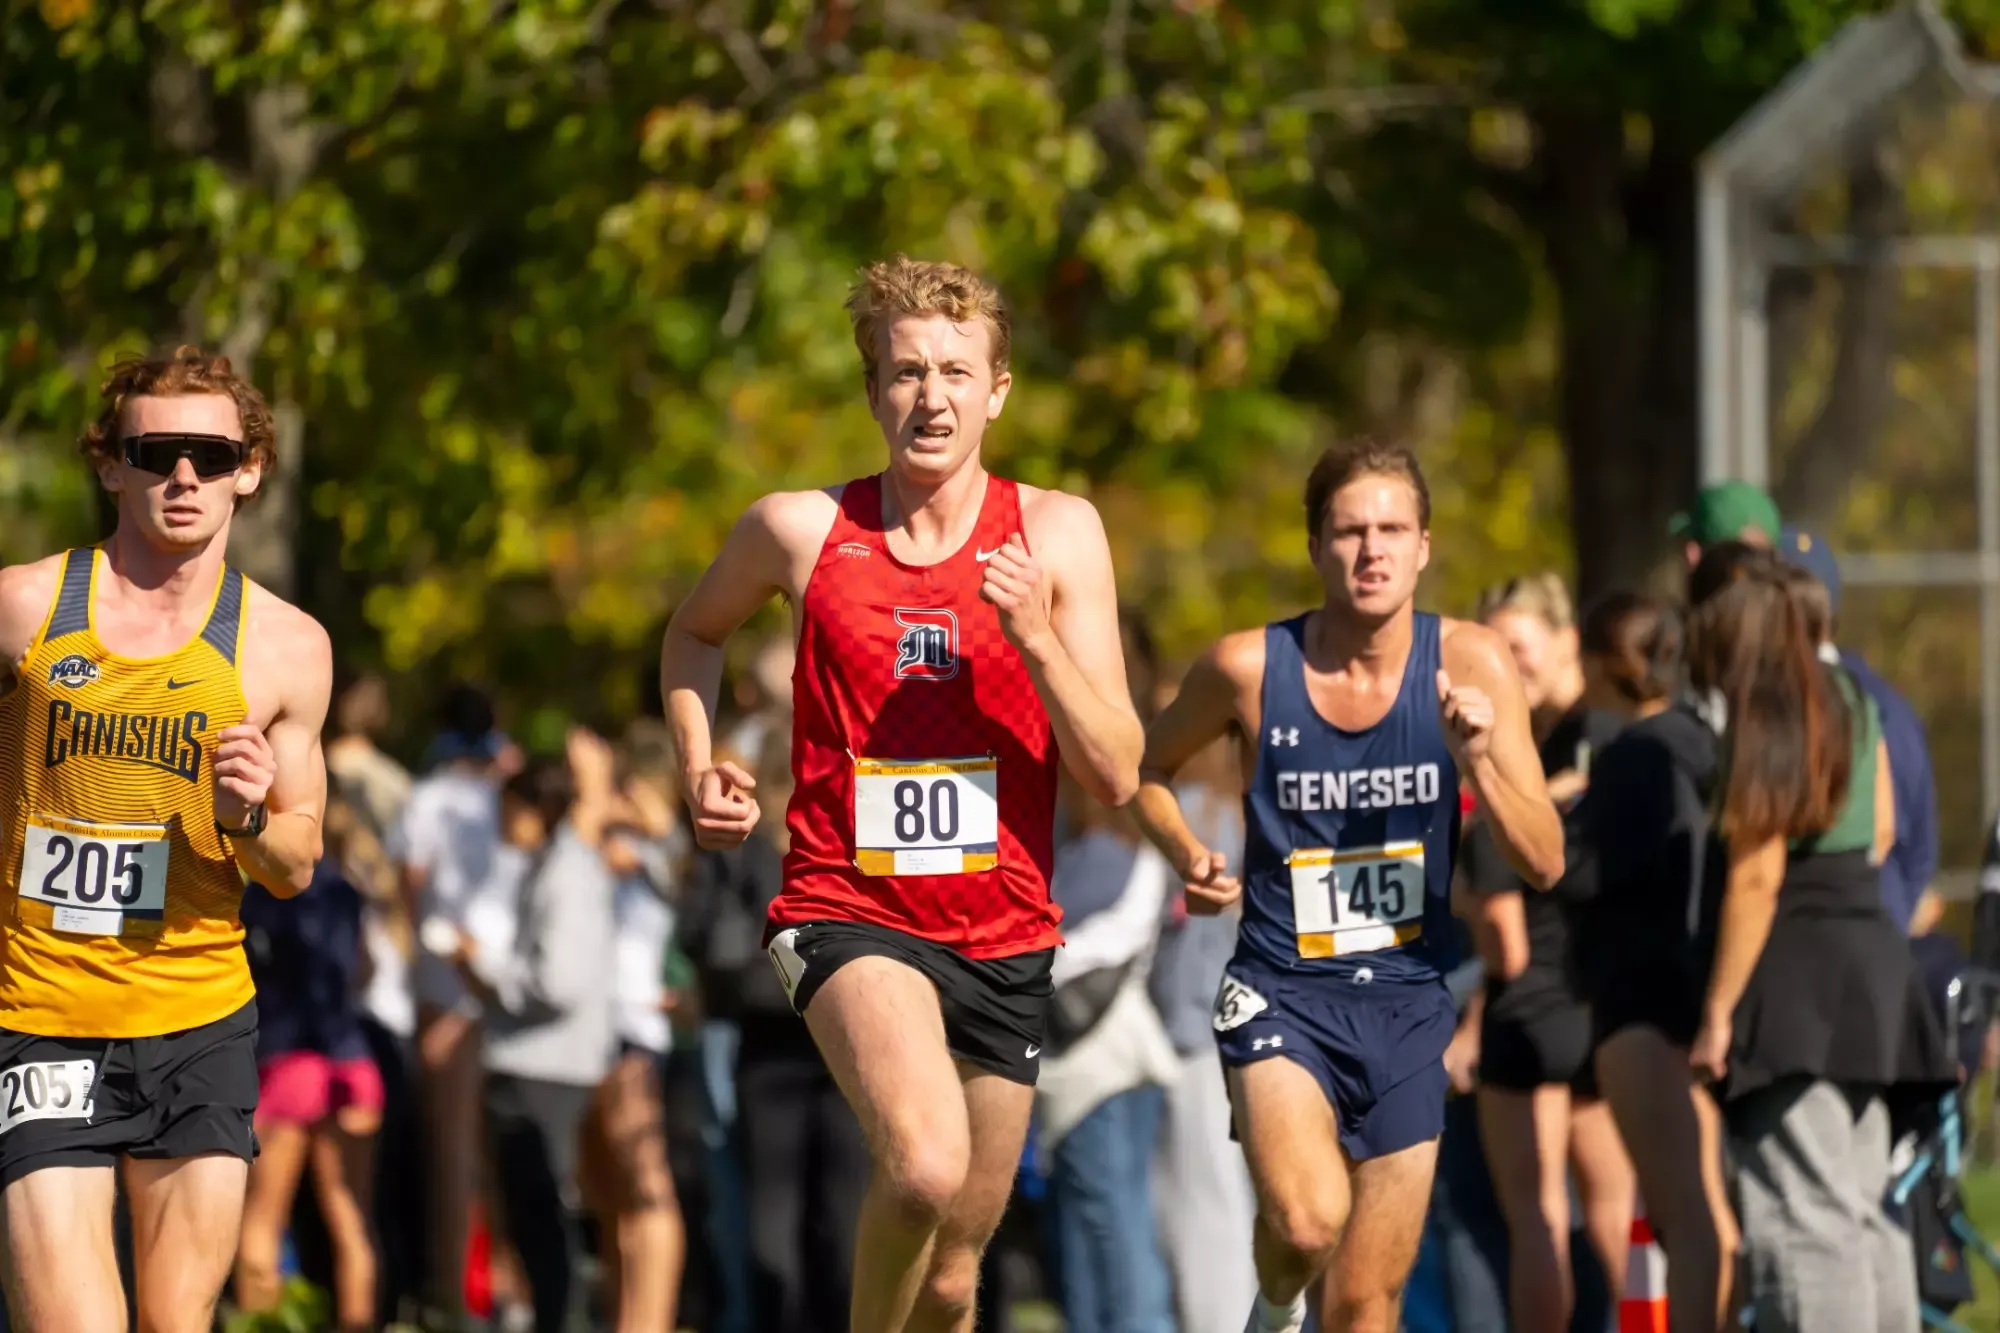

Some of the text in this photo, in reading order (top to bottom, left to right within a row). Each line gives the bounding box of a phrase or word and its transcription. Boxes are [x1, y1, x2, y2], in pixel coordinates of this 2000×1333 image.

[48, 661, 98, 682] MAAC
[45, 699, 208, 784] CANISIUS
[894, 779, 959, 843] 80
[1277, 762, 1440, 811] GENESEO
[41, 835, 144, 905] 205
[1318, 863, 1405, 925] 145
[2, 1064, 72, 1119] 205
